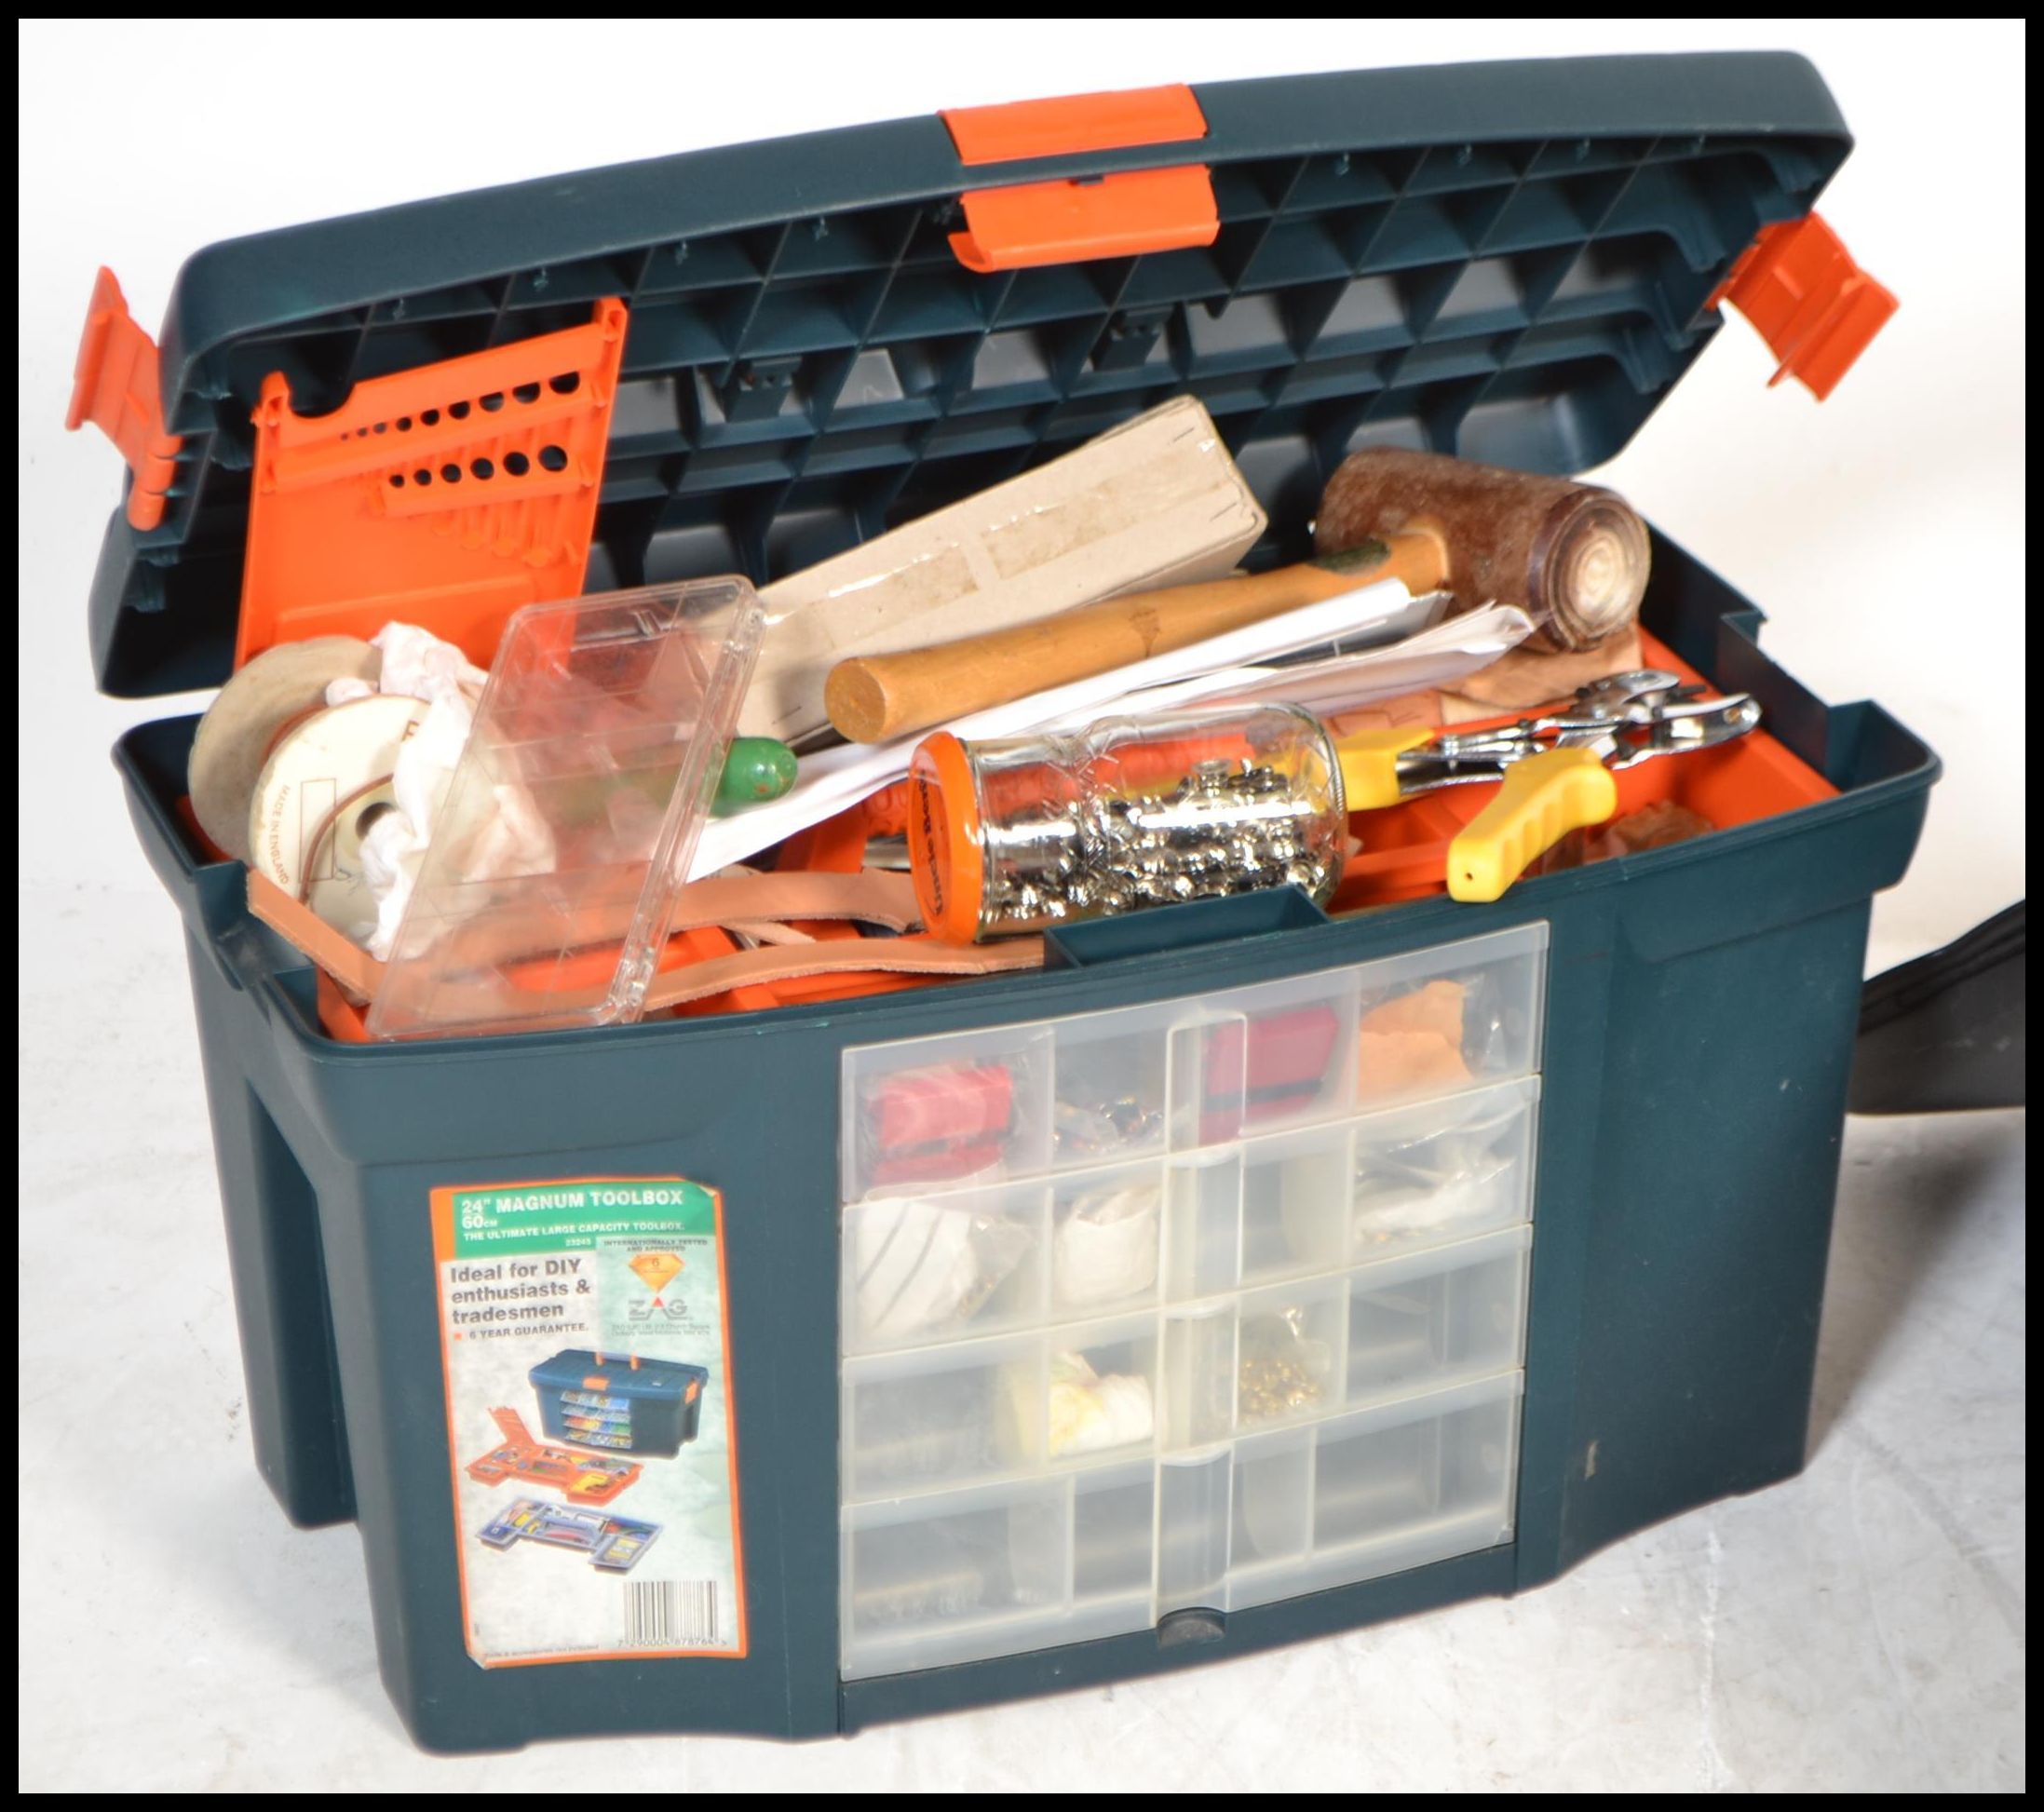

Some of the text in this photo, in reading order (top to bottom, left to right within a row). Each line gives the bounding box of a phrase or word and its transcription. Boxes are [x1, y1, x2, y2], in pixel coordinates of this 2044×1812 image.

[269, 784, 291, 885] MADE IN ENGLAND
[461, 1190, 684, 1215] 24" MAGNUM TOOLBOX
[463, 1232, 485, 1241] THE
[487, 1227, 539, 1239] ULTIMATE
[542, 1224, 575, 1236] LARGE
[578, 1222, 629, 1234] CAPACITY
[451, 1259, 581, 1283] Ideal for DIY
[451, 1278, 591, 1305] enthusiasts &
[452, 1304, 564, 1325] tradesmen
[468, 1331, 477, 1340] 6
[480, 1328, 510, 1339] YEAR
